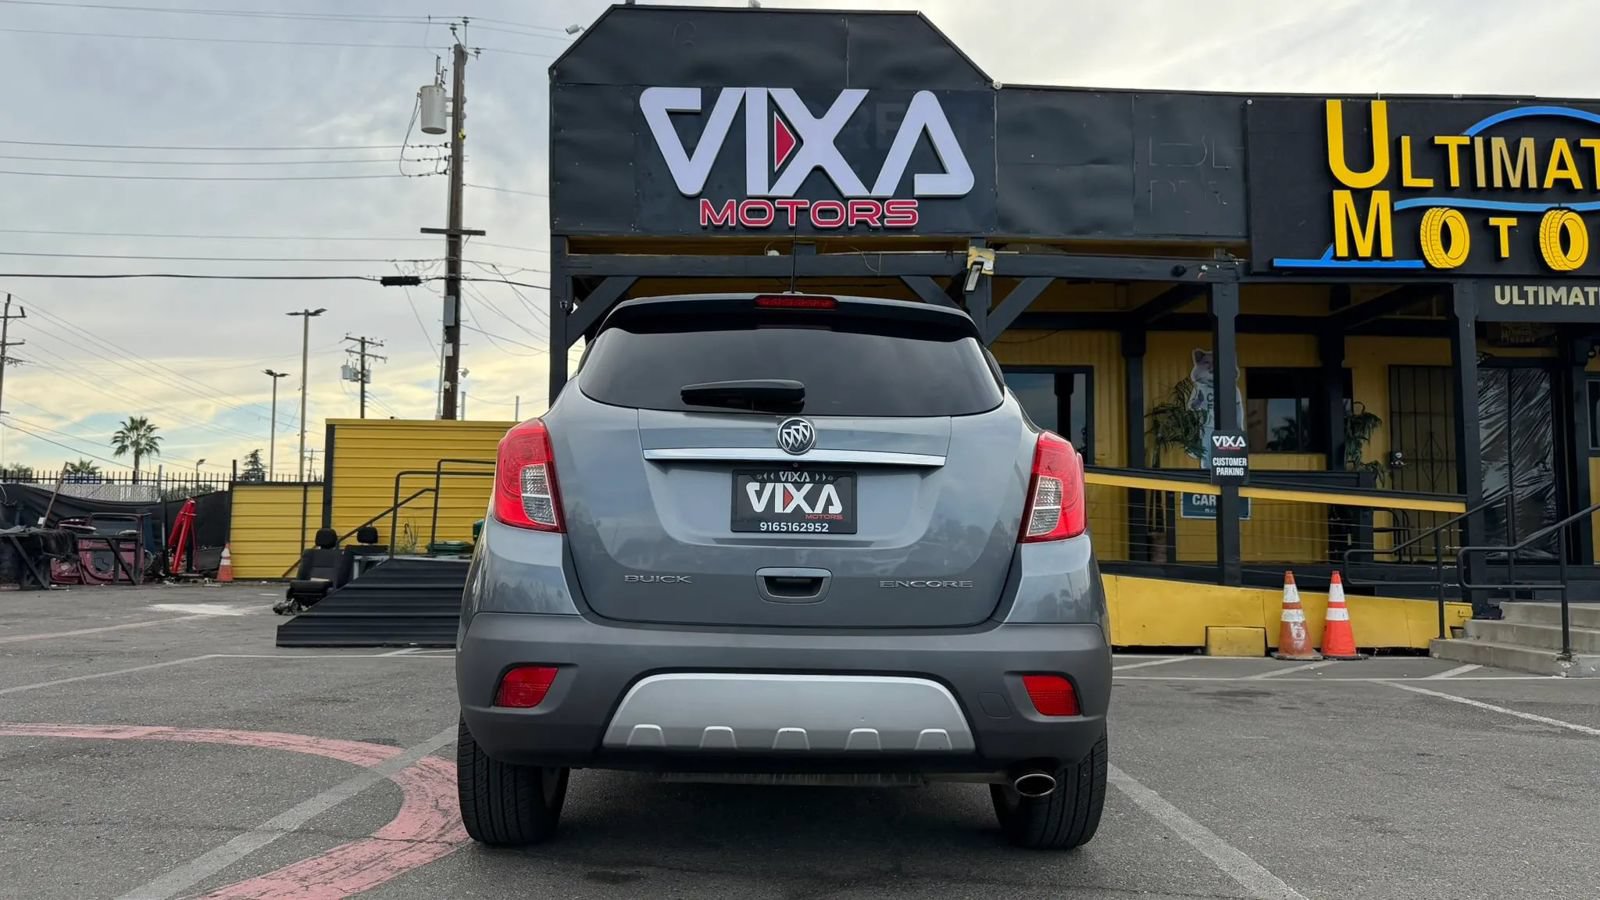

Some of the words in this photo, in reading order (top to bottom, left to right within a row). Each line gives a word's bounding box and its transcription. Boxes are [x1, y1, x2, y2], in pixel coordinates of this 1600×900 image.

[639, 86, 976, 198] VIXA
[699, 198, 920, 230] MOTORS
[1494, 285, 1600, 306] ULTIMAT
[1212, 435, 1247, 447] VIXA
[1212, 457, 1247, 467] CUSTOMER
[779, 471, 811, 482] VIXA
[1216, 467, 1244, 476] PARKING
[745, 481, 843, 514] VIXA
[759, 521, 830, 533] 9165162952
[624, 574, 693, 584] BUICK
[879, 580, 974, 588] ENCORE
